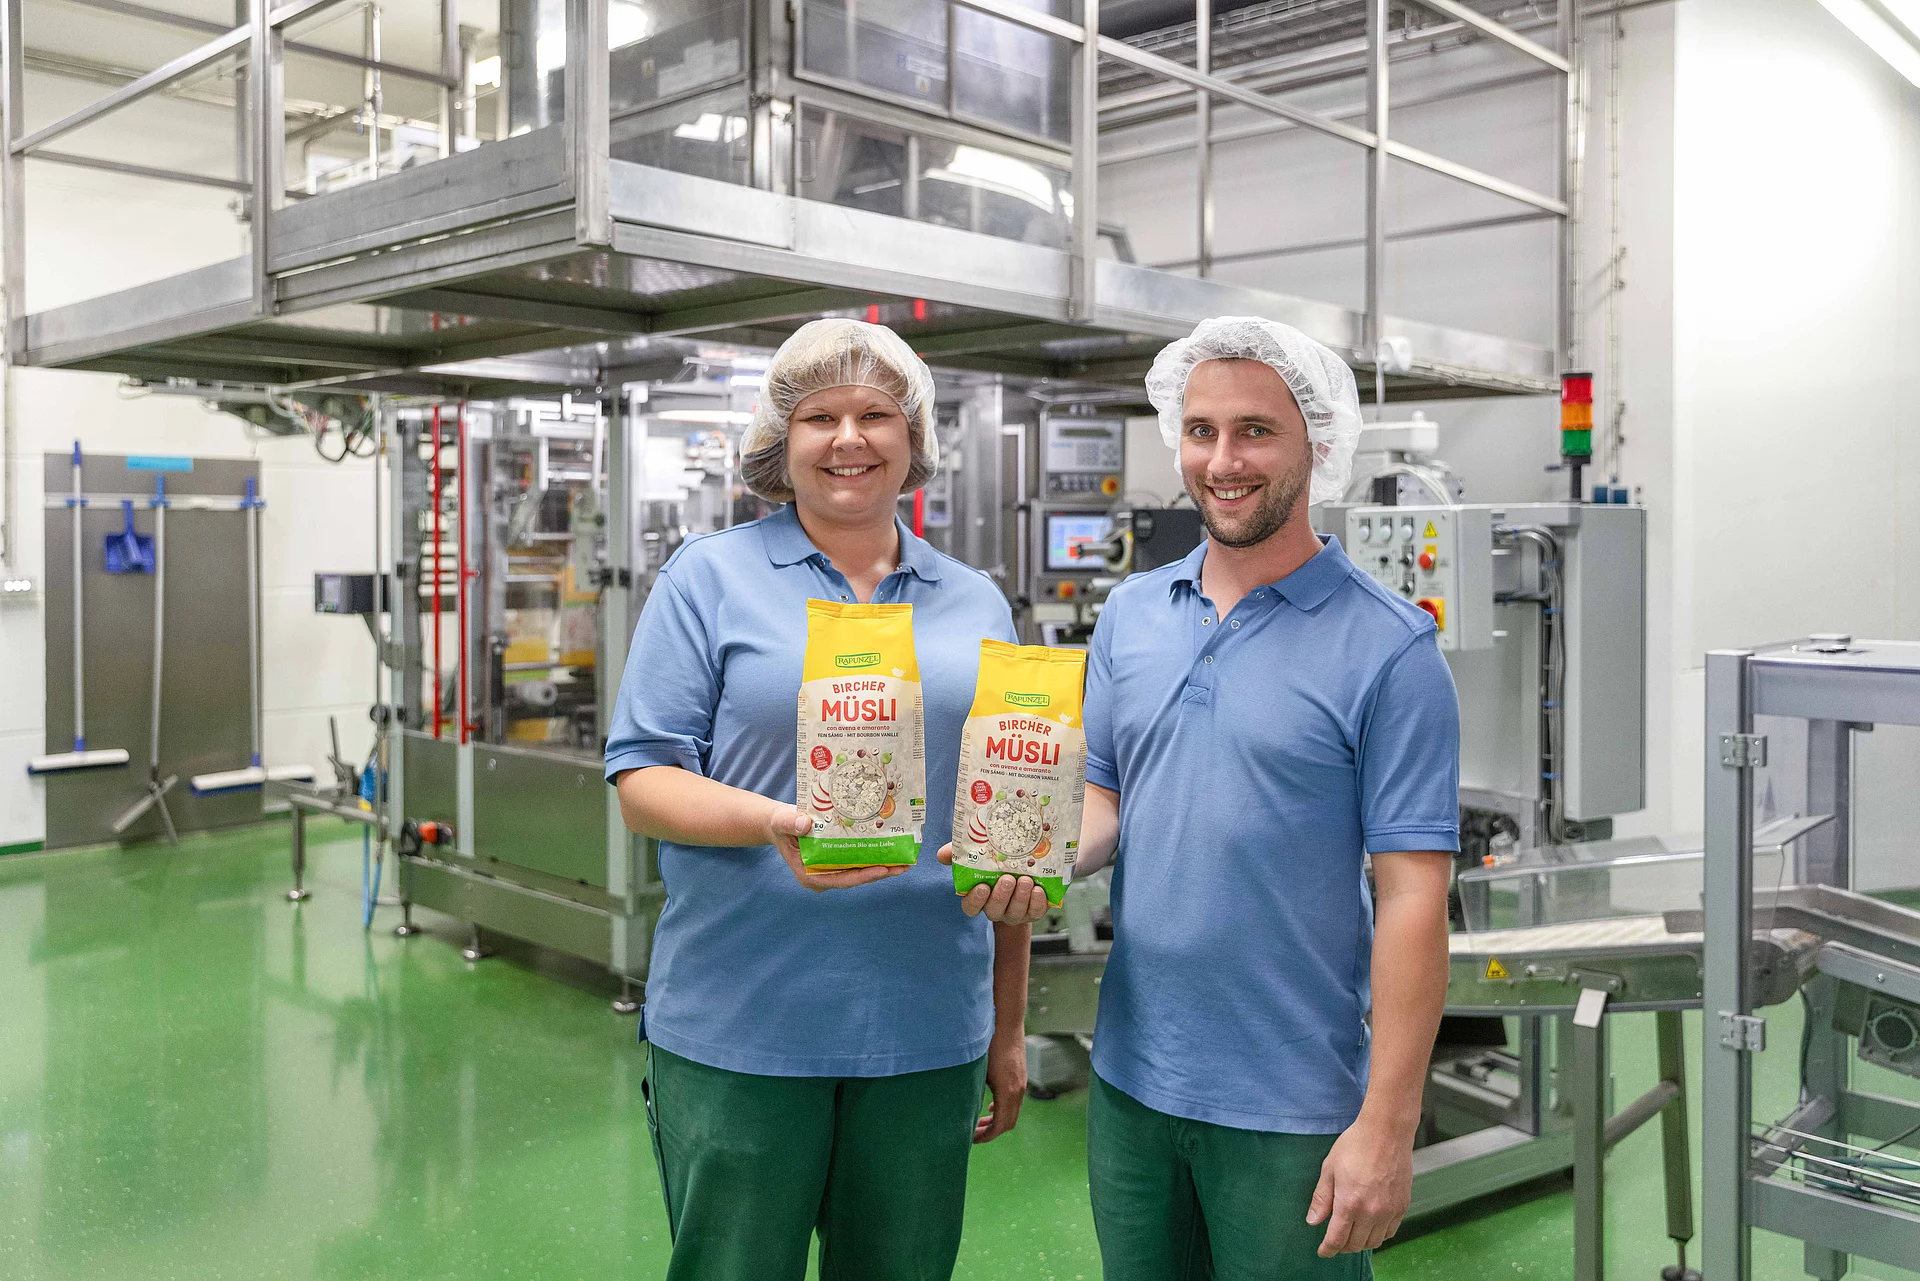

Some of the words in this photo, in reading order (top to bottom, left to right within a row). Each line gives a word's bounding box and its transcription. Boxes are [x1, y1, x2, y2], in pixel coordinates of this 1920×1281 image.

[837, 655, 878, 666] RAPUNZEL
[832, 681, 886, 694] BIRCHER
[1007, 693, 1048, 704] RAPUNZEL
[821, 695, 897, 722] MÜSLI
[998, 719, 1052, 737] BIRCHER
[985, 733, 1061, 766] MÜSLI
[1023, 766, 1052, 774] amaranto
